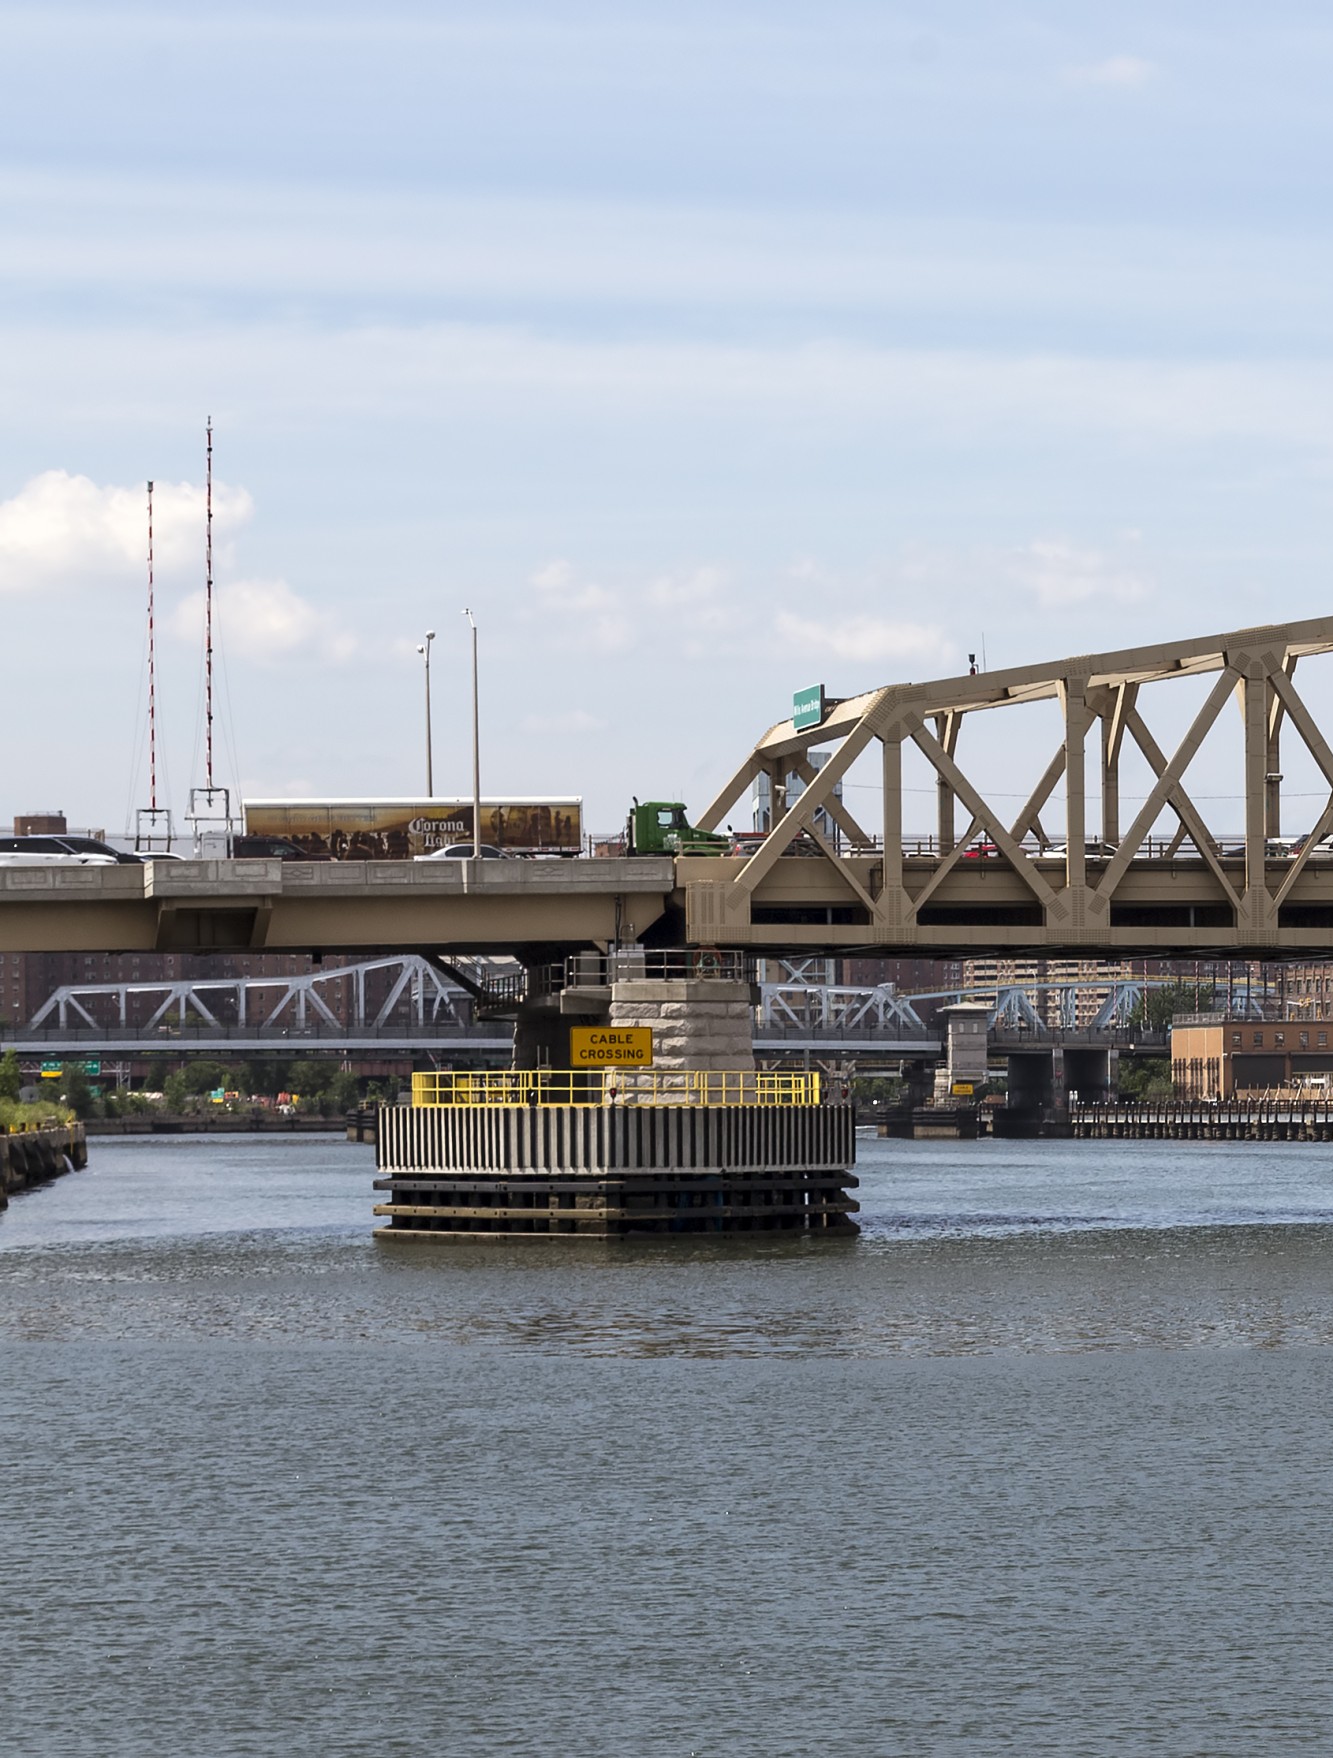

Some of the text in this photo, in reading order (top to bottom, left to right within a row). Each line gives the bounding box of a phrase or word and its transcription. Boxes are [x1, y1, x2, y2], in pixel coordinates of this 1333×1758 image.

[408, 818, 464, 834] Corona
[590, 1034, 633, 1044] CABLE
[580, 1049, 644, 1059] CROSSING
